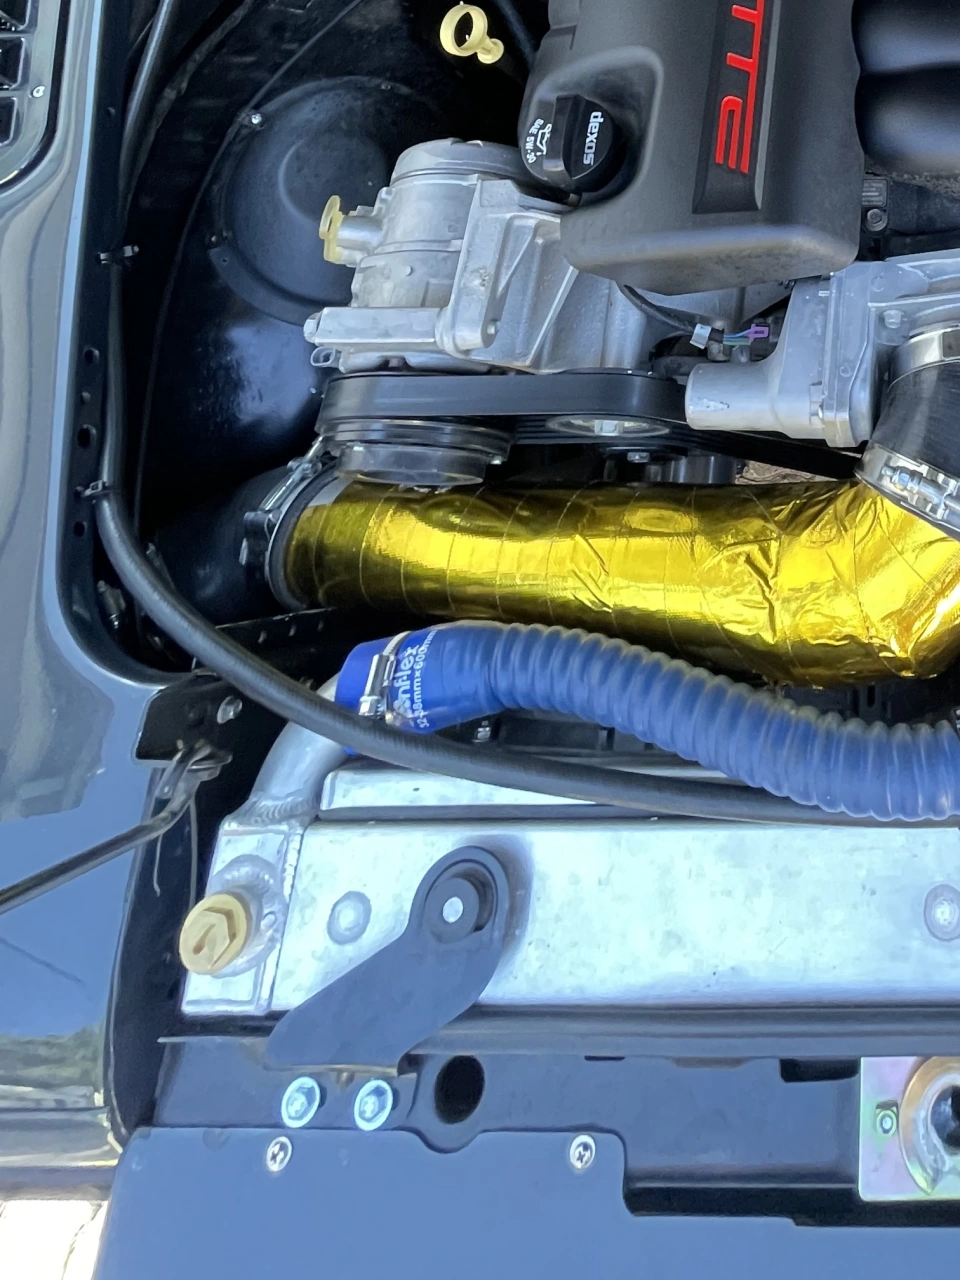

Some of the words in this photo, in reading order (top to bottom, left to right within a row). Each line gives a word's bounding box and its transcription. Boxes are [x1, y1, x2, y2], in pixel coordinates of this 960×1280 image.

[529, 118, 545, 135] SAE
[583, 111, 604, 166] dexos
[525, 136, 537, 164] 5W-30
